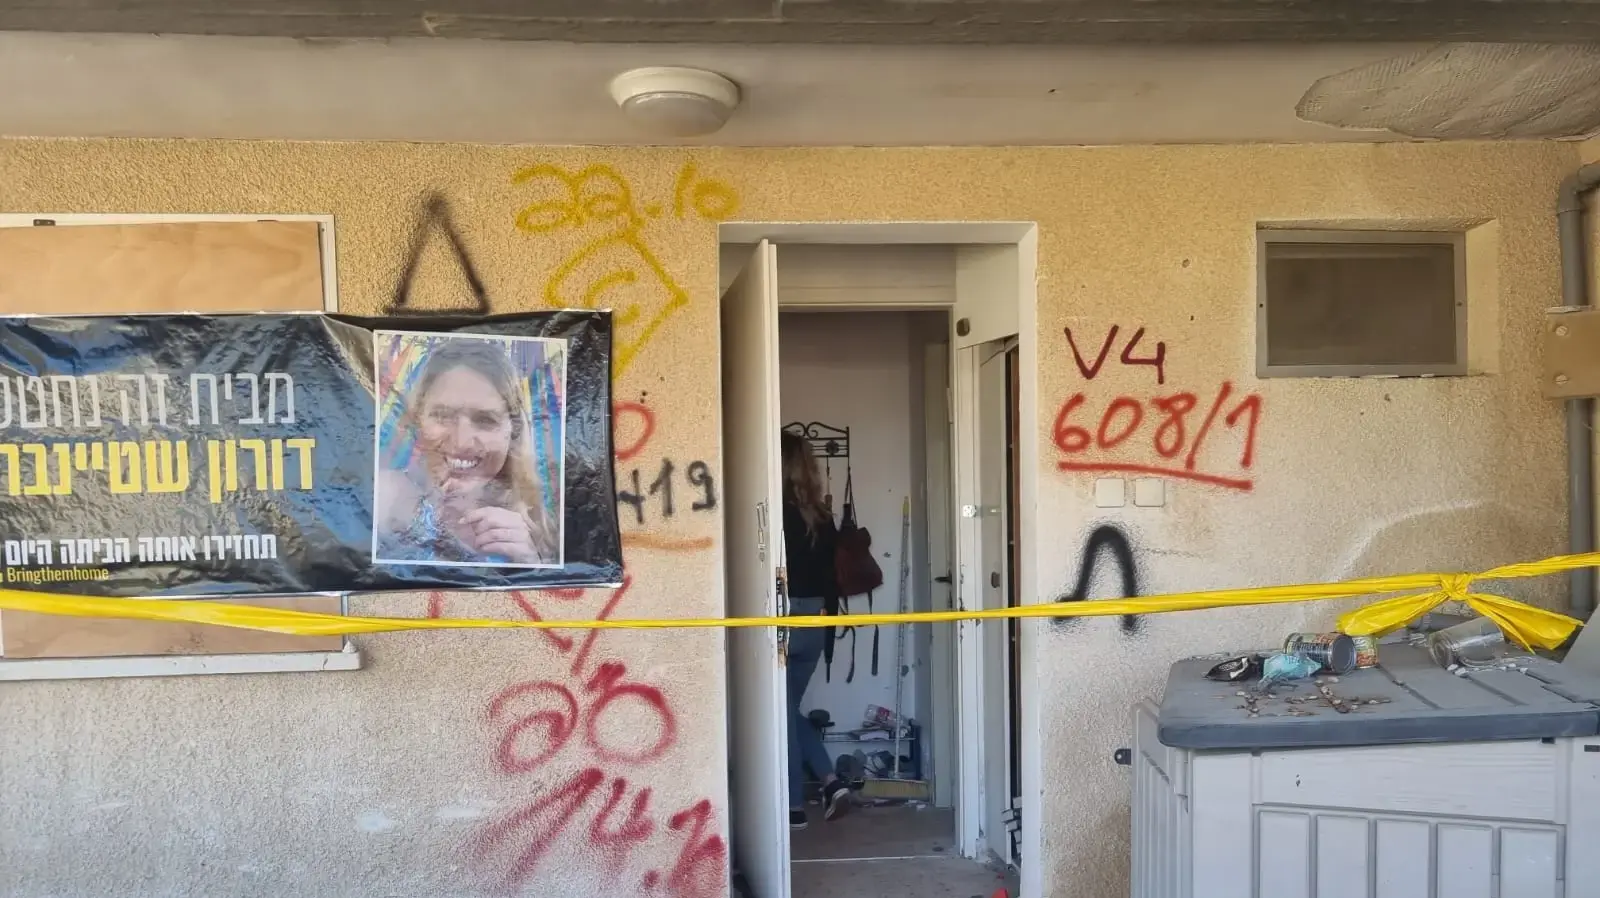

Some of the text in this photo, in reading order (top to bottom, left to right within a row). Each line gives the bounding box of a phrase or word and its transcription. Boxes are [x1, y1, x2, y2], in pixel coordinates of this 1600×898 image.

[117, 373, 170, 427] זה
[187, 372, 296, 425] מבית
[1053, 380, 1263, 470] 608/1
[207, 438, 316, 504] דורון
[5, 534, 277, 566] תחזירו אותה הביתה היום
